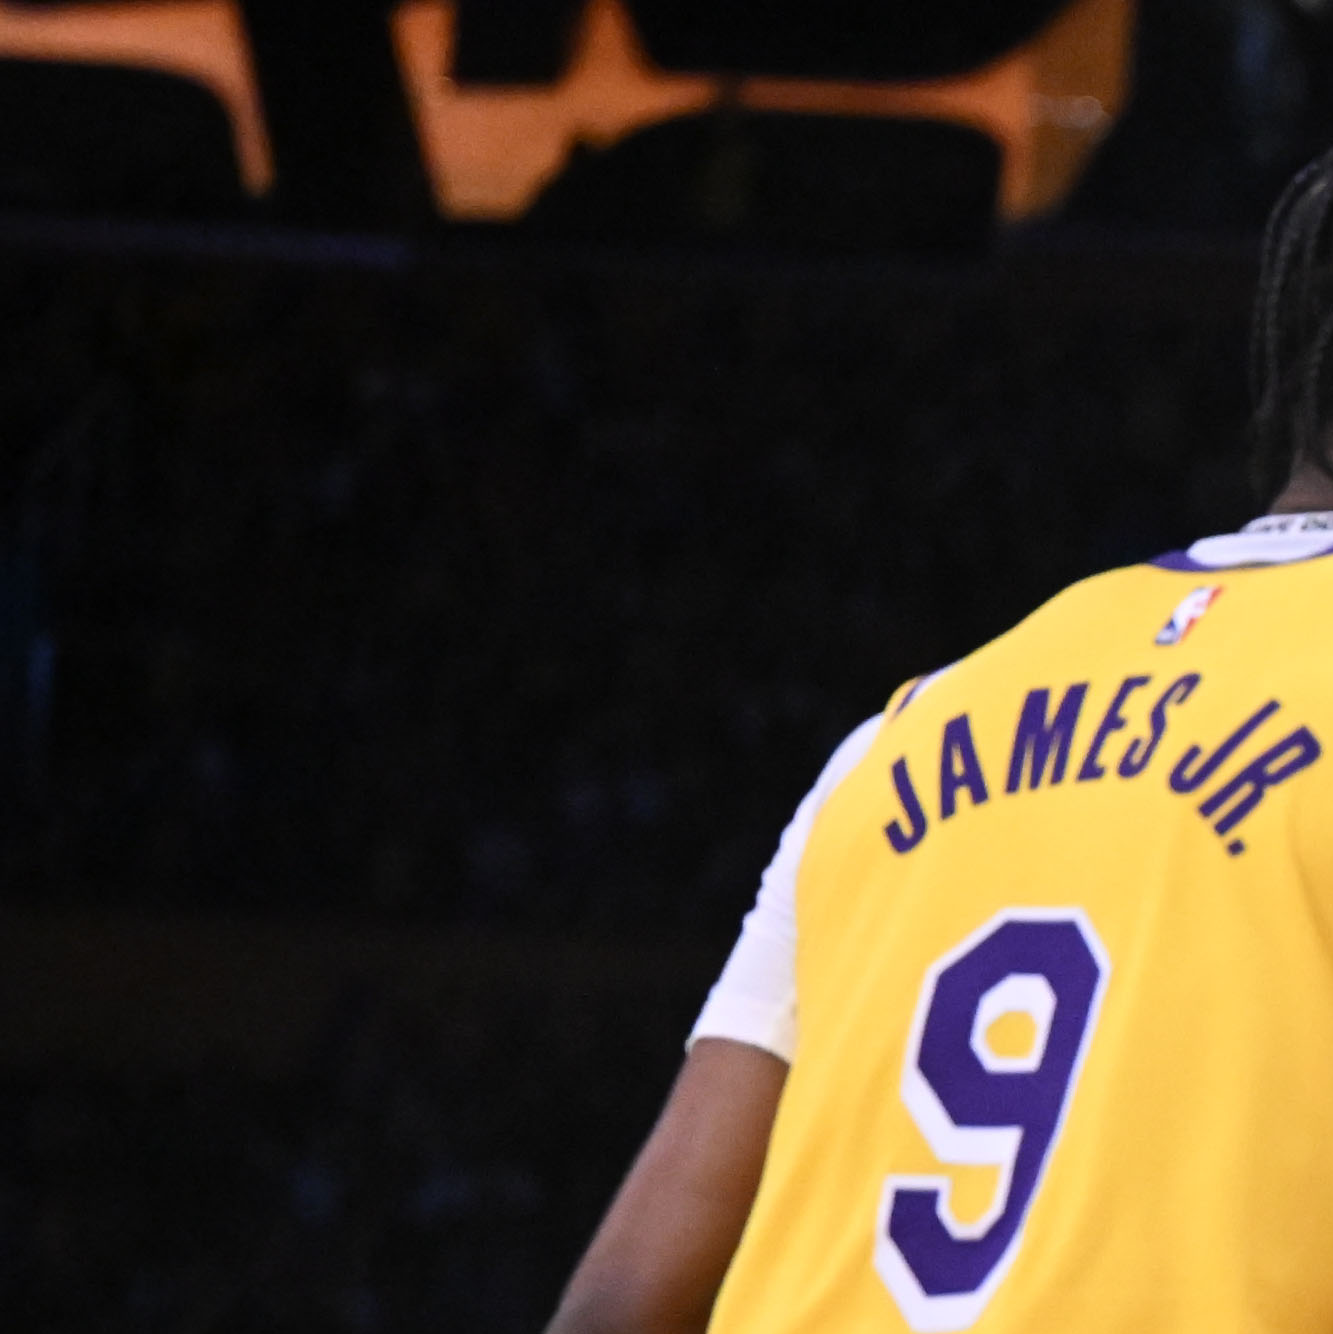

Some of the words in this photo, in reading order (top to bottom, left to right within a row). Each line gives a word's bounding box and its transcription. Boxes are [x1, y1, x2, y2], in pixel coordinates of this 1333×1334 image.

[884, 672, 1201, 854] JAMES
[1168, 698, 1322, 858] JR.
[873, 906, 1113, 1334] 9
